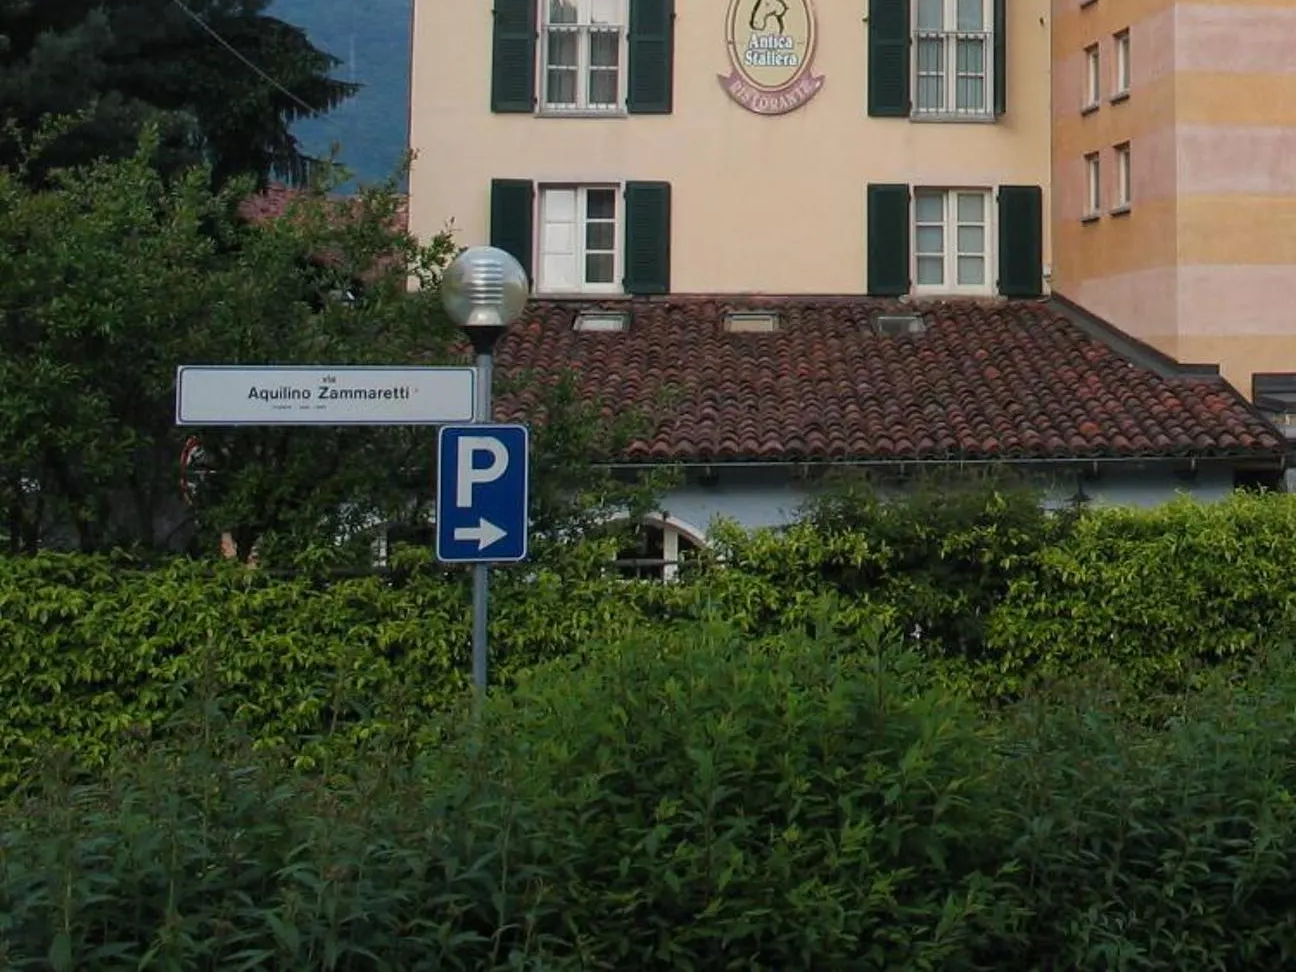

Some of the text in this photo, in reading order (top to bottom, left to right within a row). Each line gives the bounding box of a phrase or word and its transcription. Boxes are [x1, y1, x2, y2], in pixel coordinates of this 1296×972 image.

[749, 32, 793, 49] Antica
[729, 79, 812, 109] RISTORANTE
[248, 386, 410, 402] Aquilino Zammaretti
[455, 435, 509, 509] P
